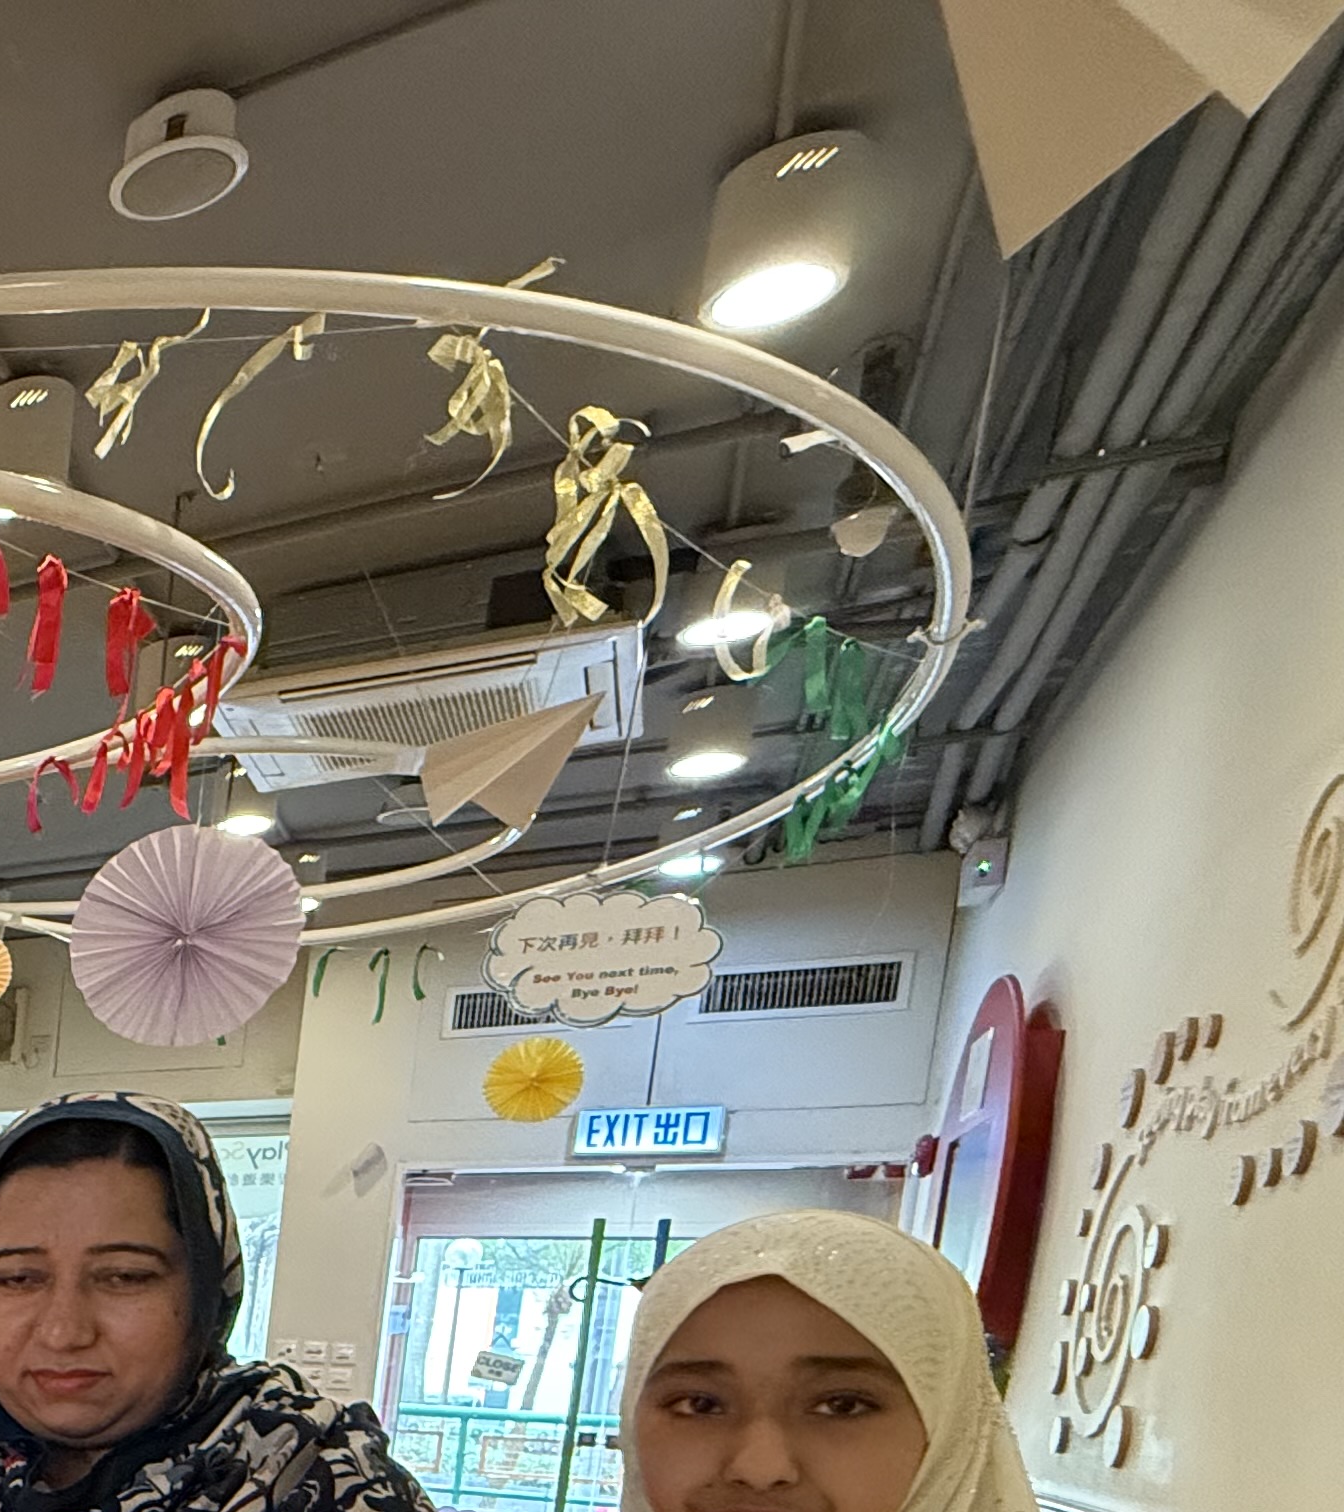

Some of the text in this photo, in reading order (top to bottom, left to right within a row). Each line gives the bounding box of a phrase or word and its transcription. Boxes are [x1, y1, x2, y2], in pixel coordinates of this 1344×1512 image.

[533, 973, 562, 984] See
[567, 971, 594, 981] You
[598, 967, 635, 979] next
[571, 984, 640, 1000] Bye Bye!
[586, 1111, 711, 1148] EXIT 出口
